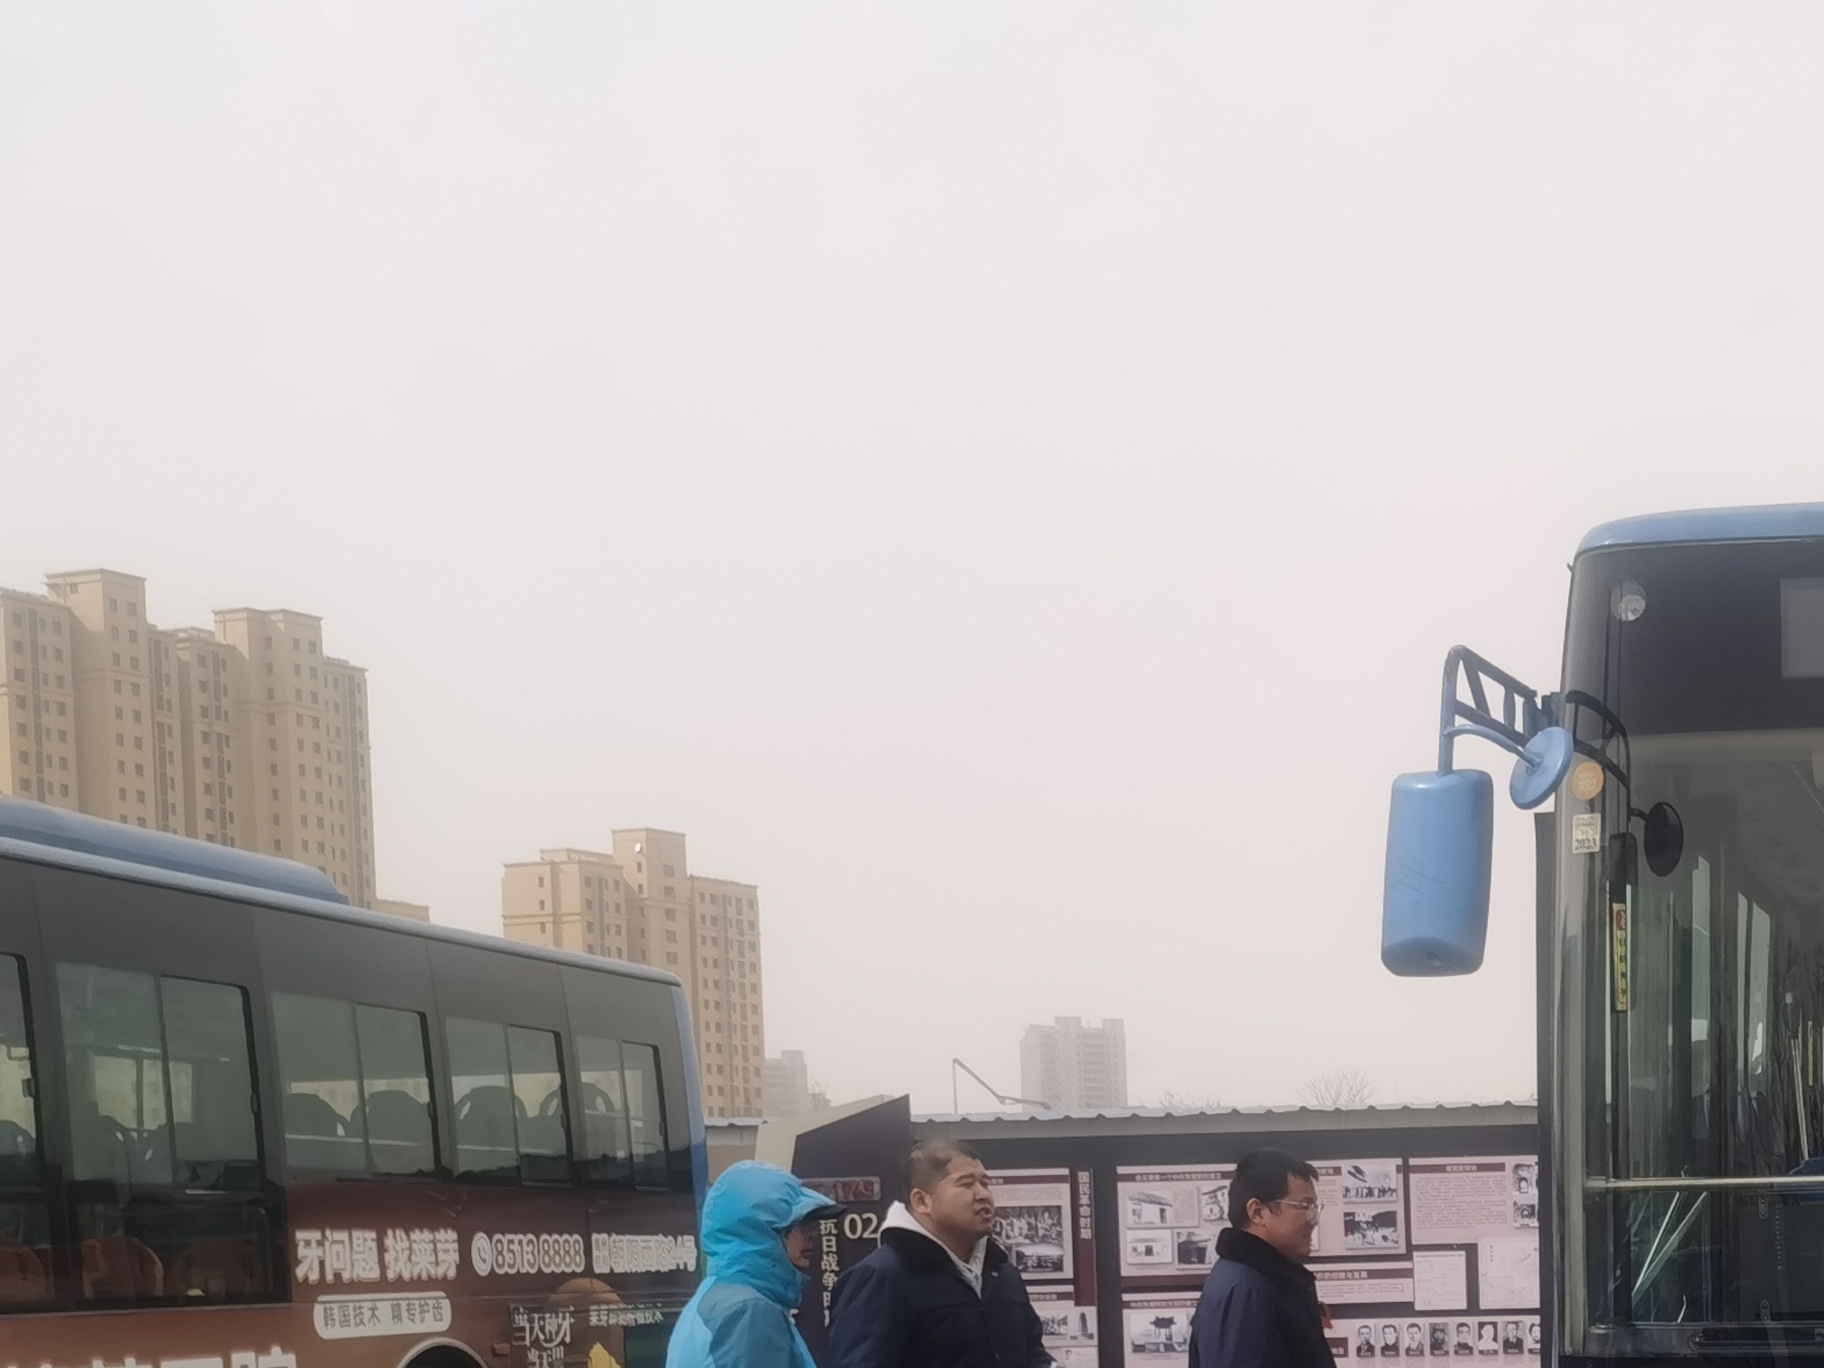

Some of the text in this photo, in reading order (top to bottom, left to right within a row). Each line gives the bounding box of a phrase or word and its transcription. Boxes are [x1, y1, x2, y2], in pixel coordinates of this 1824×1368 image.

[843, 1212, 879, 1240] 02
[294, 1228, 381, 1285] 牙问题
[492, 1232, 539, 1275] 8513
[539, 1232, 586, 1274] 8888
[819, 1219, 840, 1328] 抗日战争
[322, 1303, 382, 1331] 韩国技术
